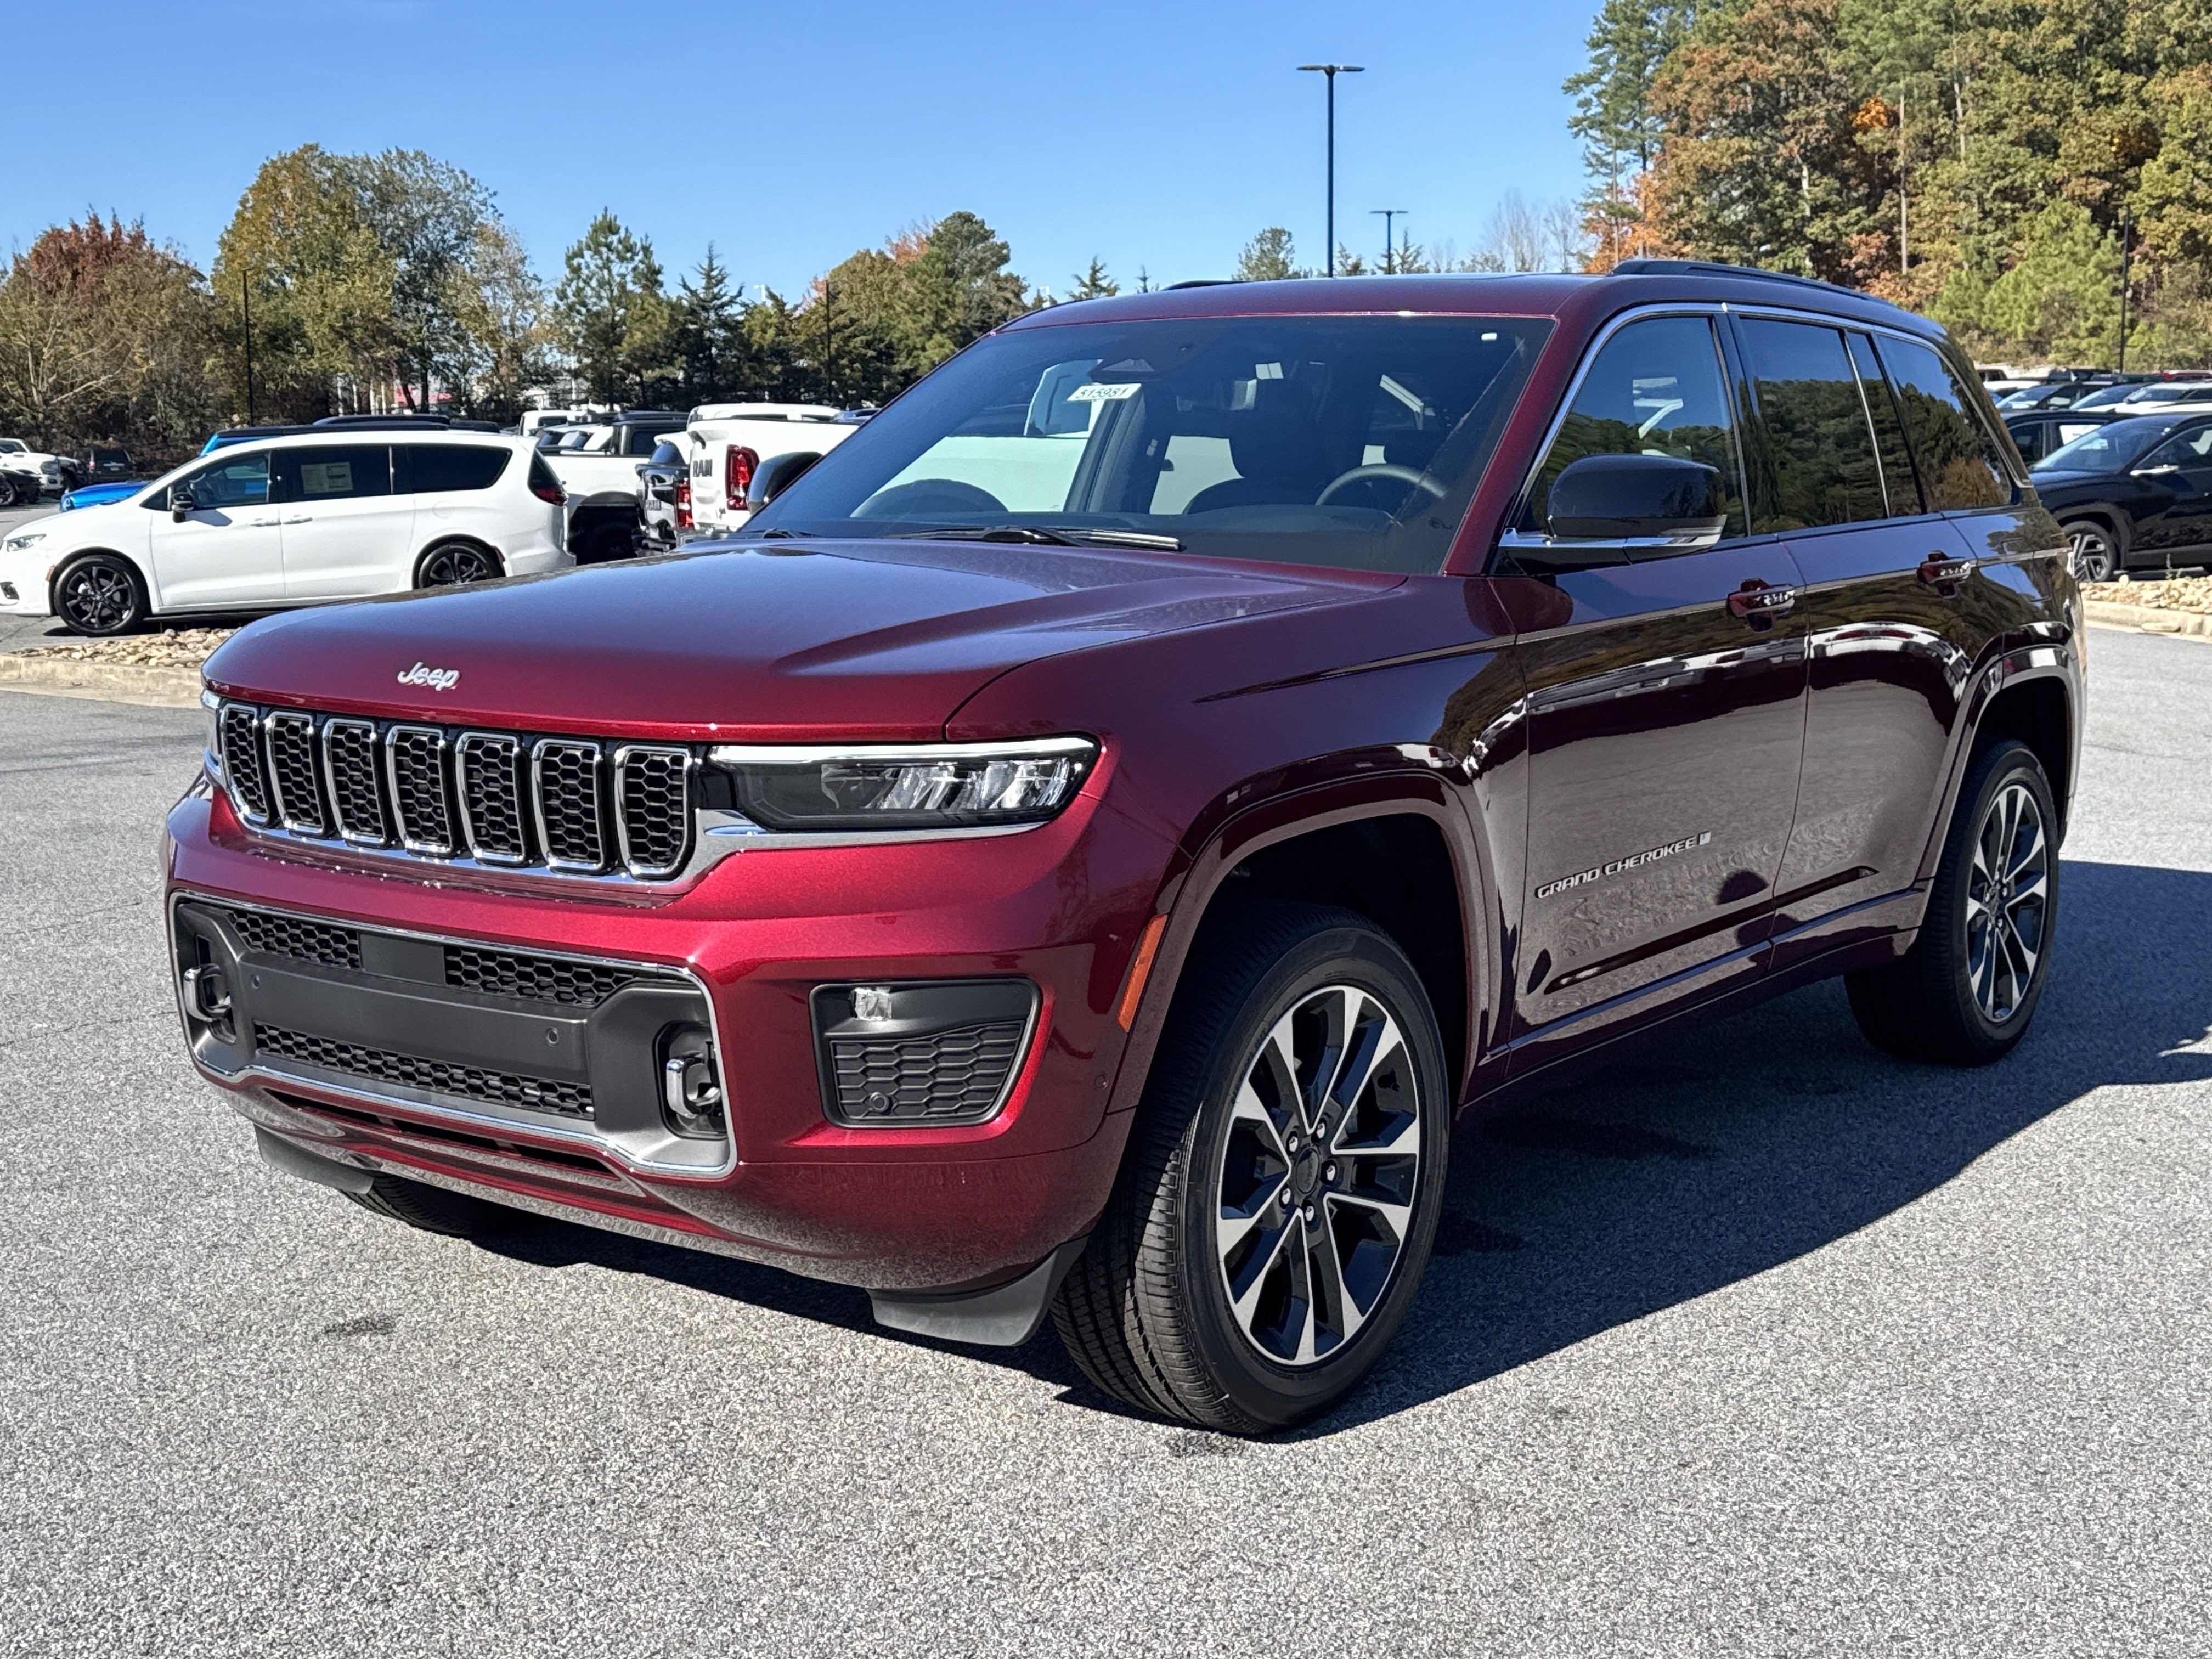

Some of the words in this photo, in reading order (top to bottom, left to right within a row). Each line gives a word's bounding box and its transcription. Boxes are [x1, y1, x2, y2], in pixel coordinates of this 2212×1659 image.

[693, 459, 713, 477] RAM
[397, 661, 461, 691] Jeep
[1534, 867, 1600, 899] GRAND
[1602, 835, 1697, 876] CHEROKEE
